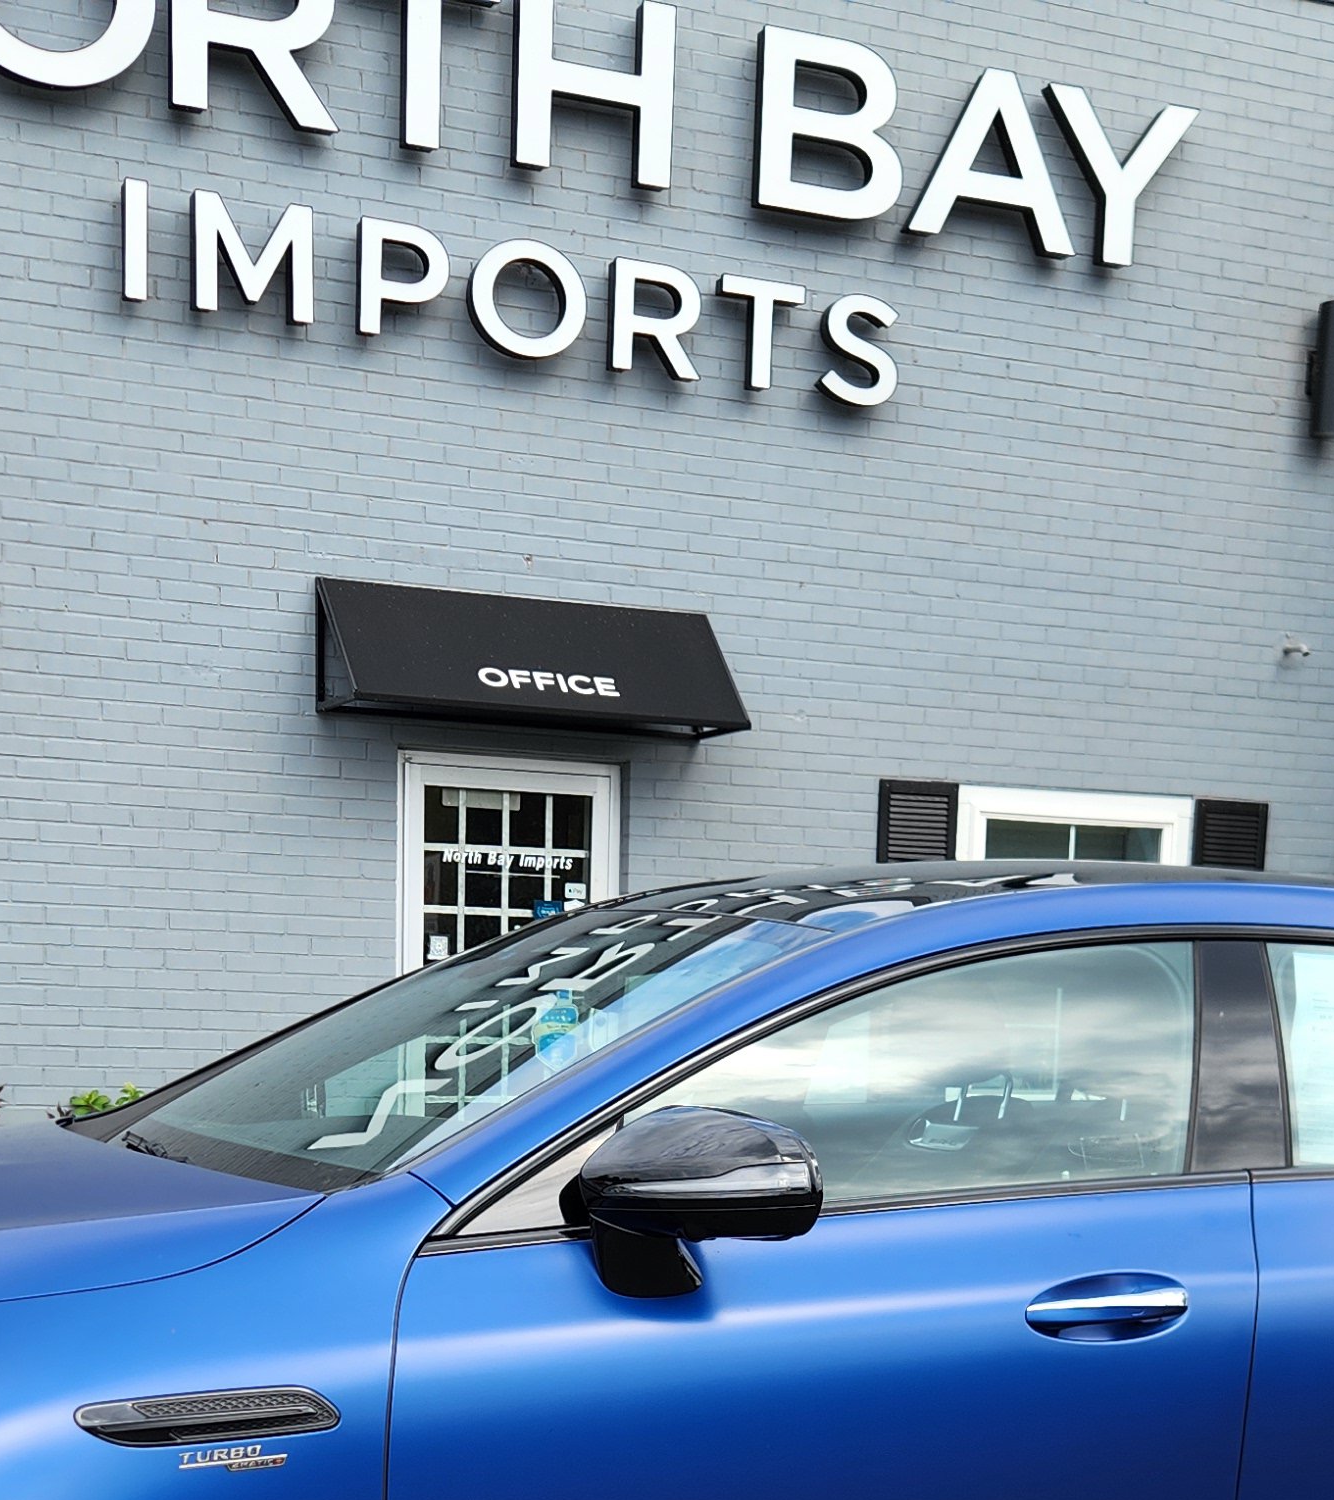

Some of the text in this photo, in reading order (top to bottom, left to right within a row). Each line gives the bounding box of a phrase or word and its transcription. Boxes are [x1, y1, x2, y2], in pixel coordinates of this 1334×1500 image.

[752, 24, 1200, 268] BAY
[121, 177, 900, 408] IMPORTS
[477, 667, 621, 698] OFFICE
[442, 849, 574, 871] North Bay Imports
[178, 1444, 262, 1464] TURBO
